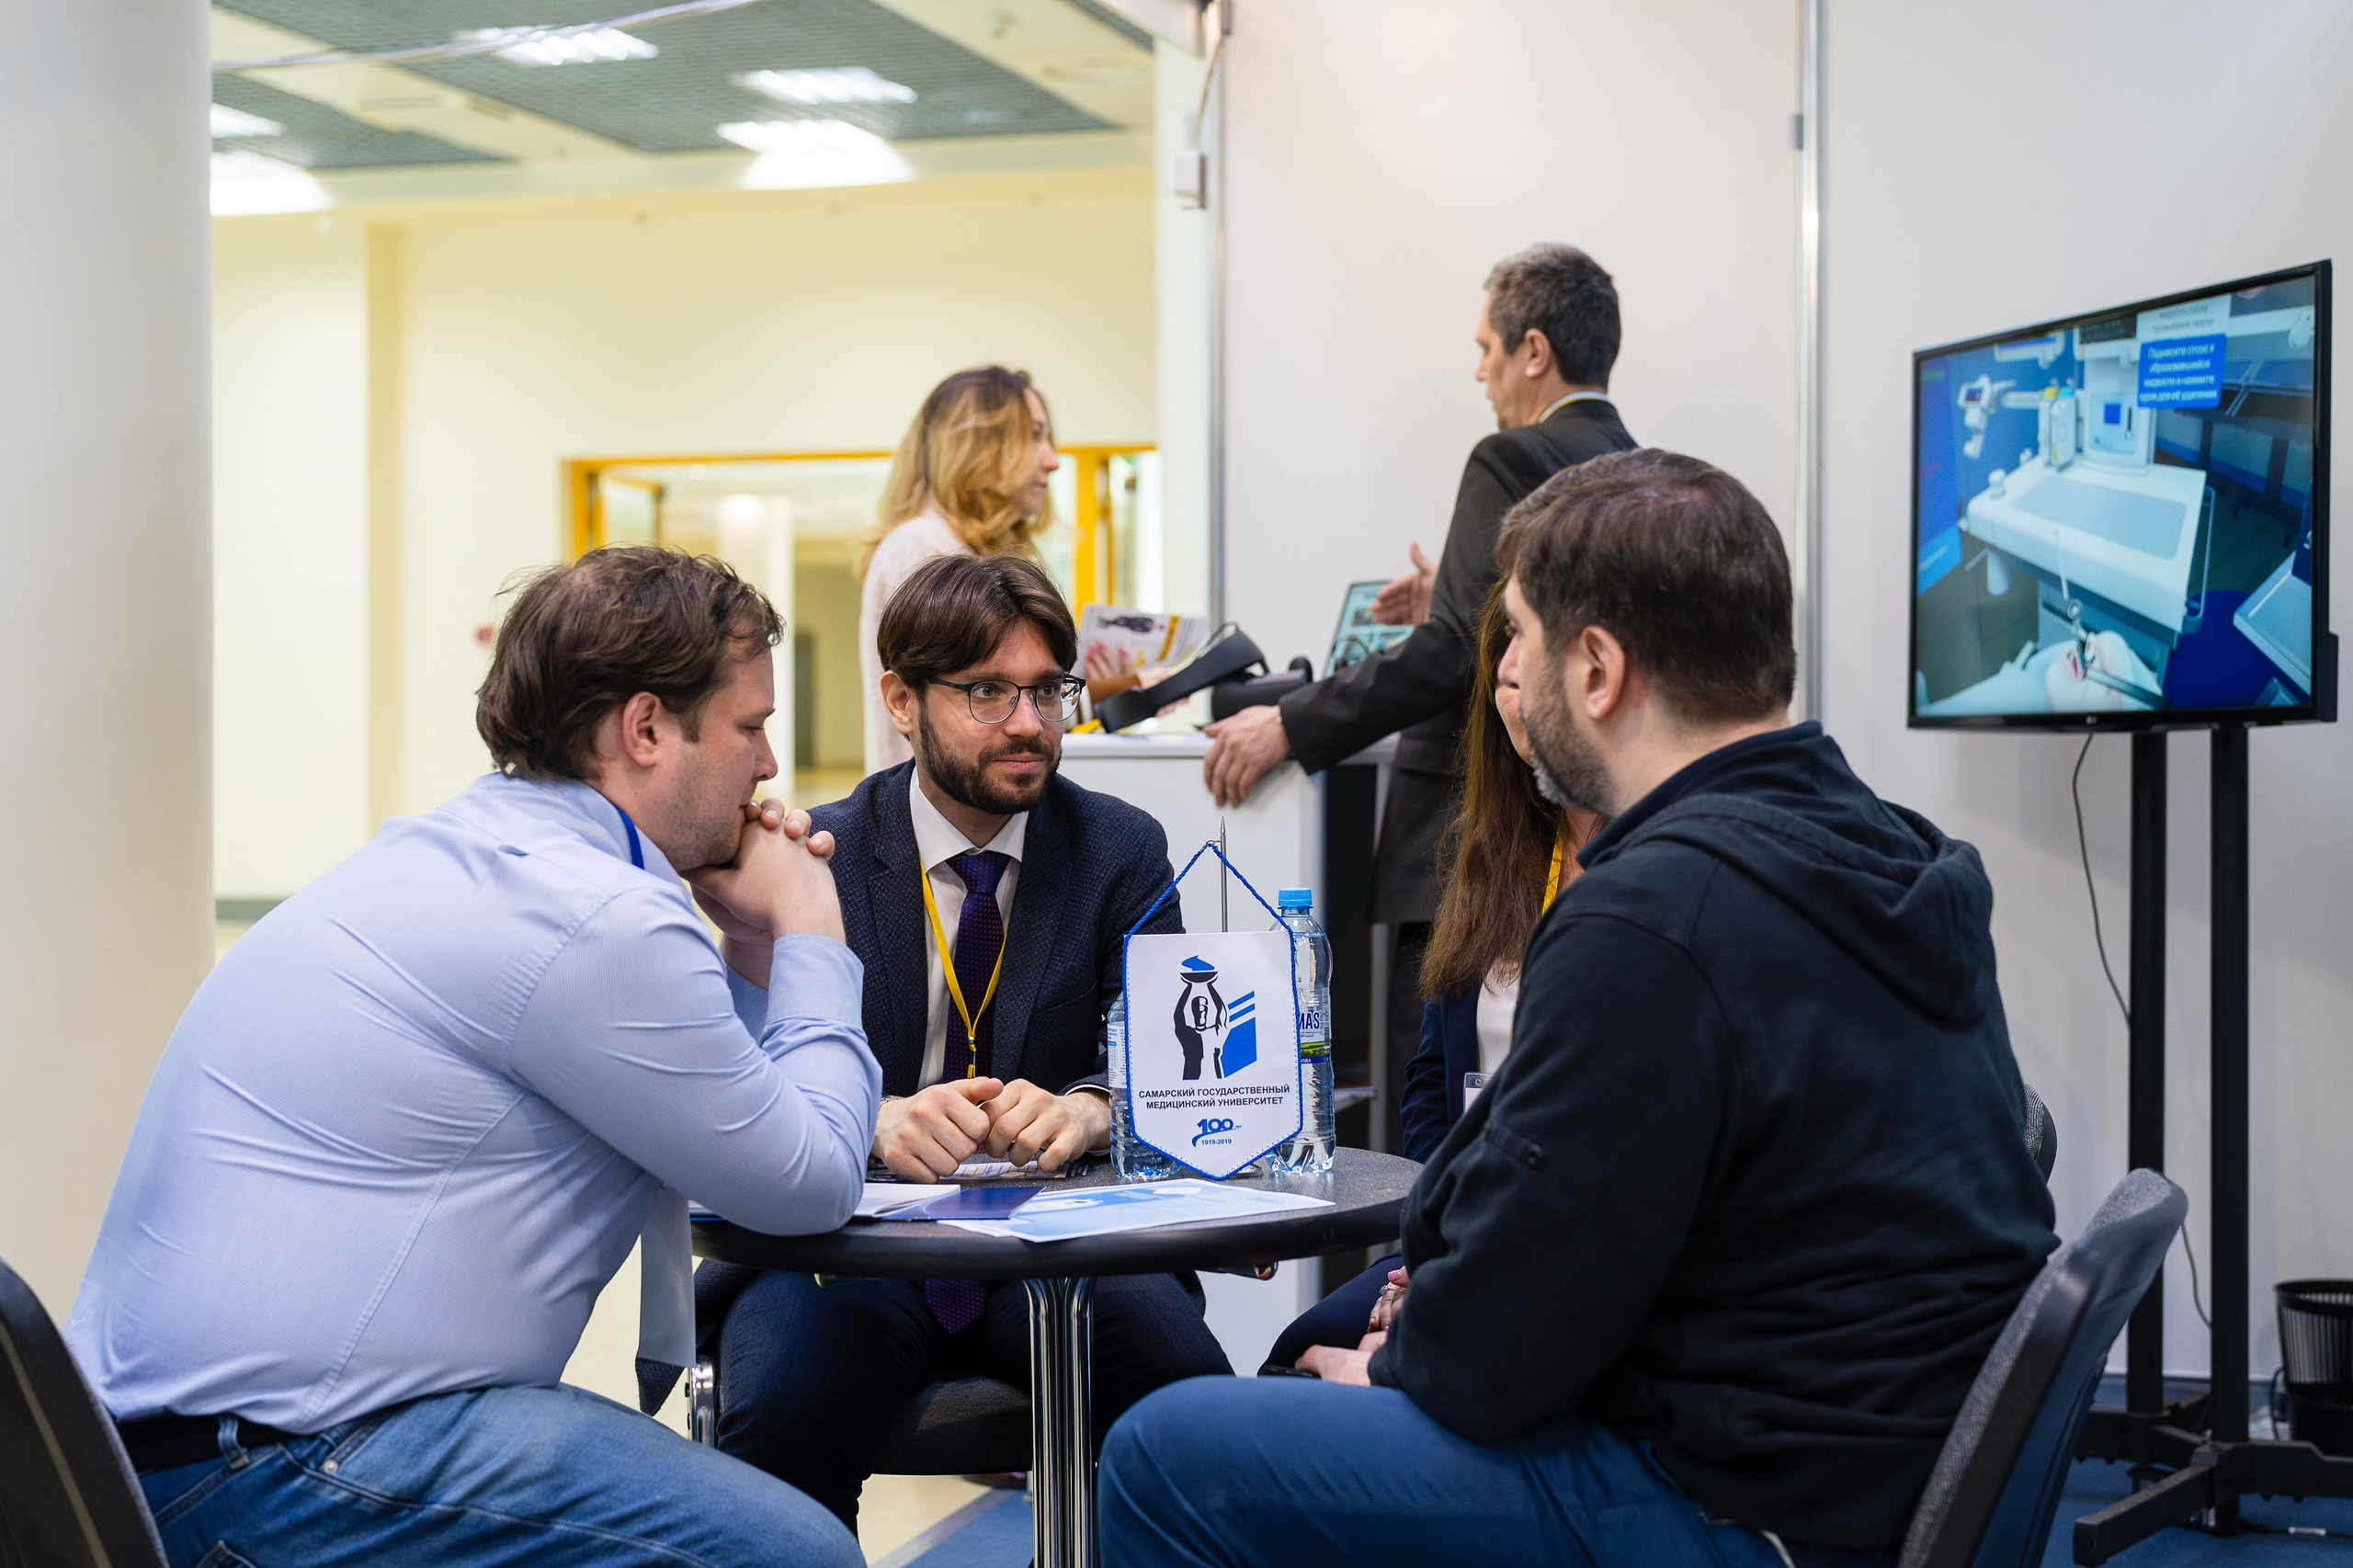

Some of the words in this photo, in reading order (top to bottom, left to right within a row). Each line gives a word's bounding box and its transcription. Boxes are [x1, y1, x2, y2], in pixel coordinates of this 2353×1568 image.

[1138, 1086, 1195, 1098] САМАРСКИЙ
[1197, 1084, 1290, 1096] ГОСУДАРСТВЕННЫЙ
[1146, 1097, 1216, 1110] МЕДИЦИНСКИЙ
[1218, 1096, 1284, 1108] УНИВЕРСИТЕТ
[1197, 1118, 1233, 1136] 100
[1200, 1138, 1233, 1146] 1919-2019
